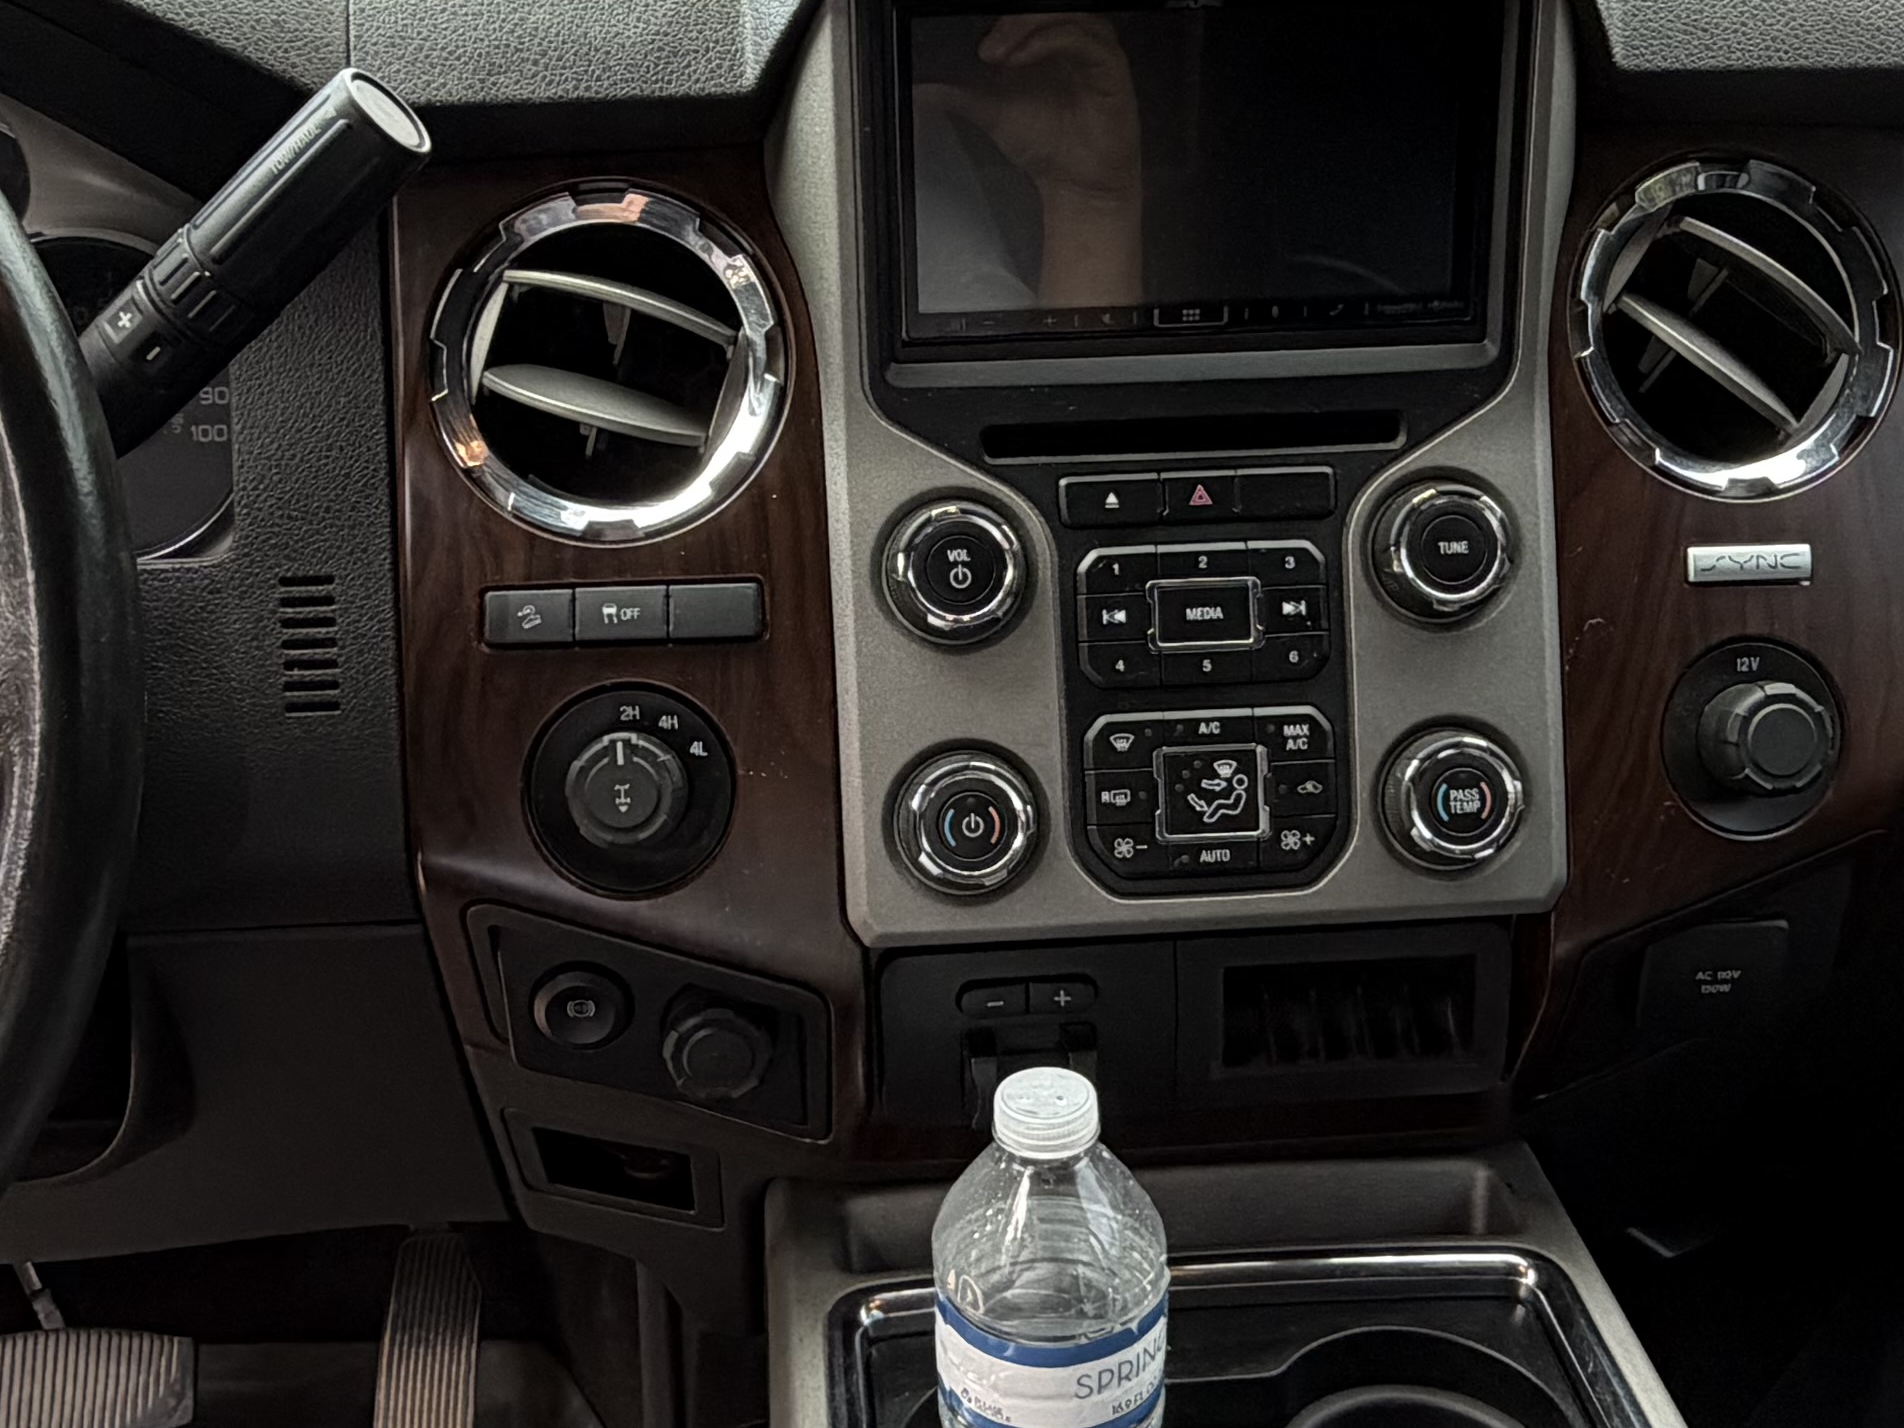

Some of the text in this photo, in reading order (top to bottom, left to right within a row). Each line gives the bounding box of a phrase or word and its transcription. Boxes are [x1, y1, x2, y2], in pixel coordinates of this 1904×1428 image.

[268, 119, 324, 176] TOW/HAUL
[199, 386, 230, 406] 90
[189, 423, 228, 443] 100
[946, 548, 972, 563] VOL
[1437, 540, 1470, 556] TUNE
[1111, 562, 1120, 576] 1
[1197, 555, 1209, 569] 2
[1284, 555, 1296, 570] 3
[1699, 551, 1806, 572] SYNC
[620, 606, 642, 621] OFF
[1185, 605, 1224, 622] MEDIA
[1288, 650, 1300, 664] 6
[1735, 655, 1761, 673] 12V
[1114, 658, 1125, 673] 4
[1201, 658, 1212, 673] 5
[618, 704, 641, 722] 2H
[657, 714, 679, 731] 4H
[1197, 721, 1221, 735] A/C
[1282, 723, 1310, 737] MAX
[689, 740, 709, 758] 4L
[1285, 737, 1309, 751] A/C
[1449, 788, 1480, 803] PASS
[1449, 800, 1481, 815] TEMP
[1199, 849, 1231, 864] AUTO
